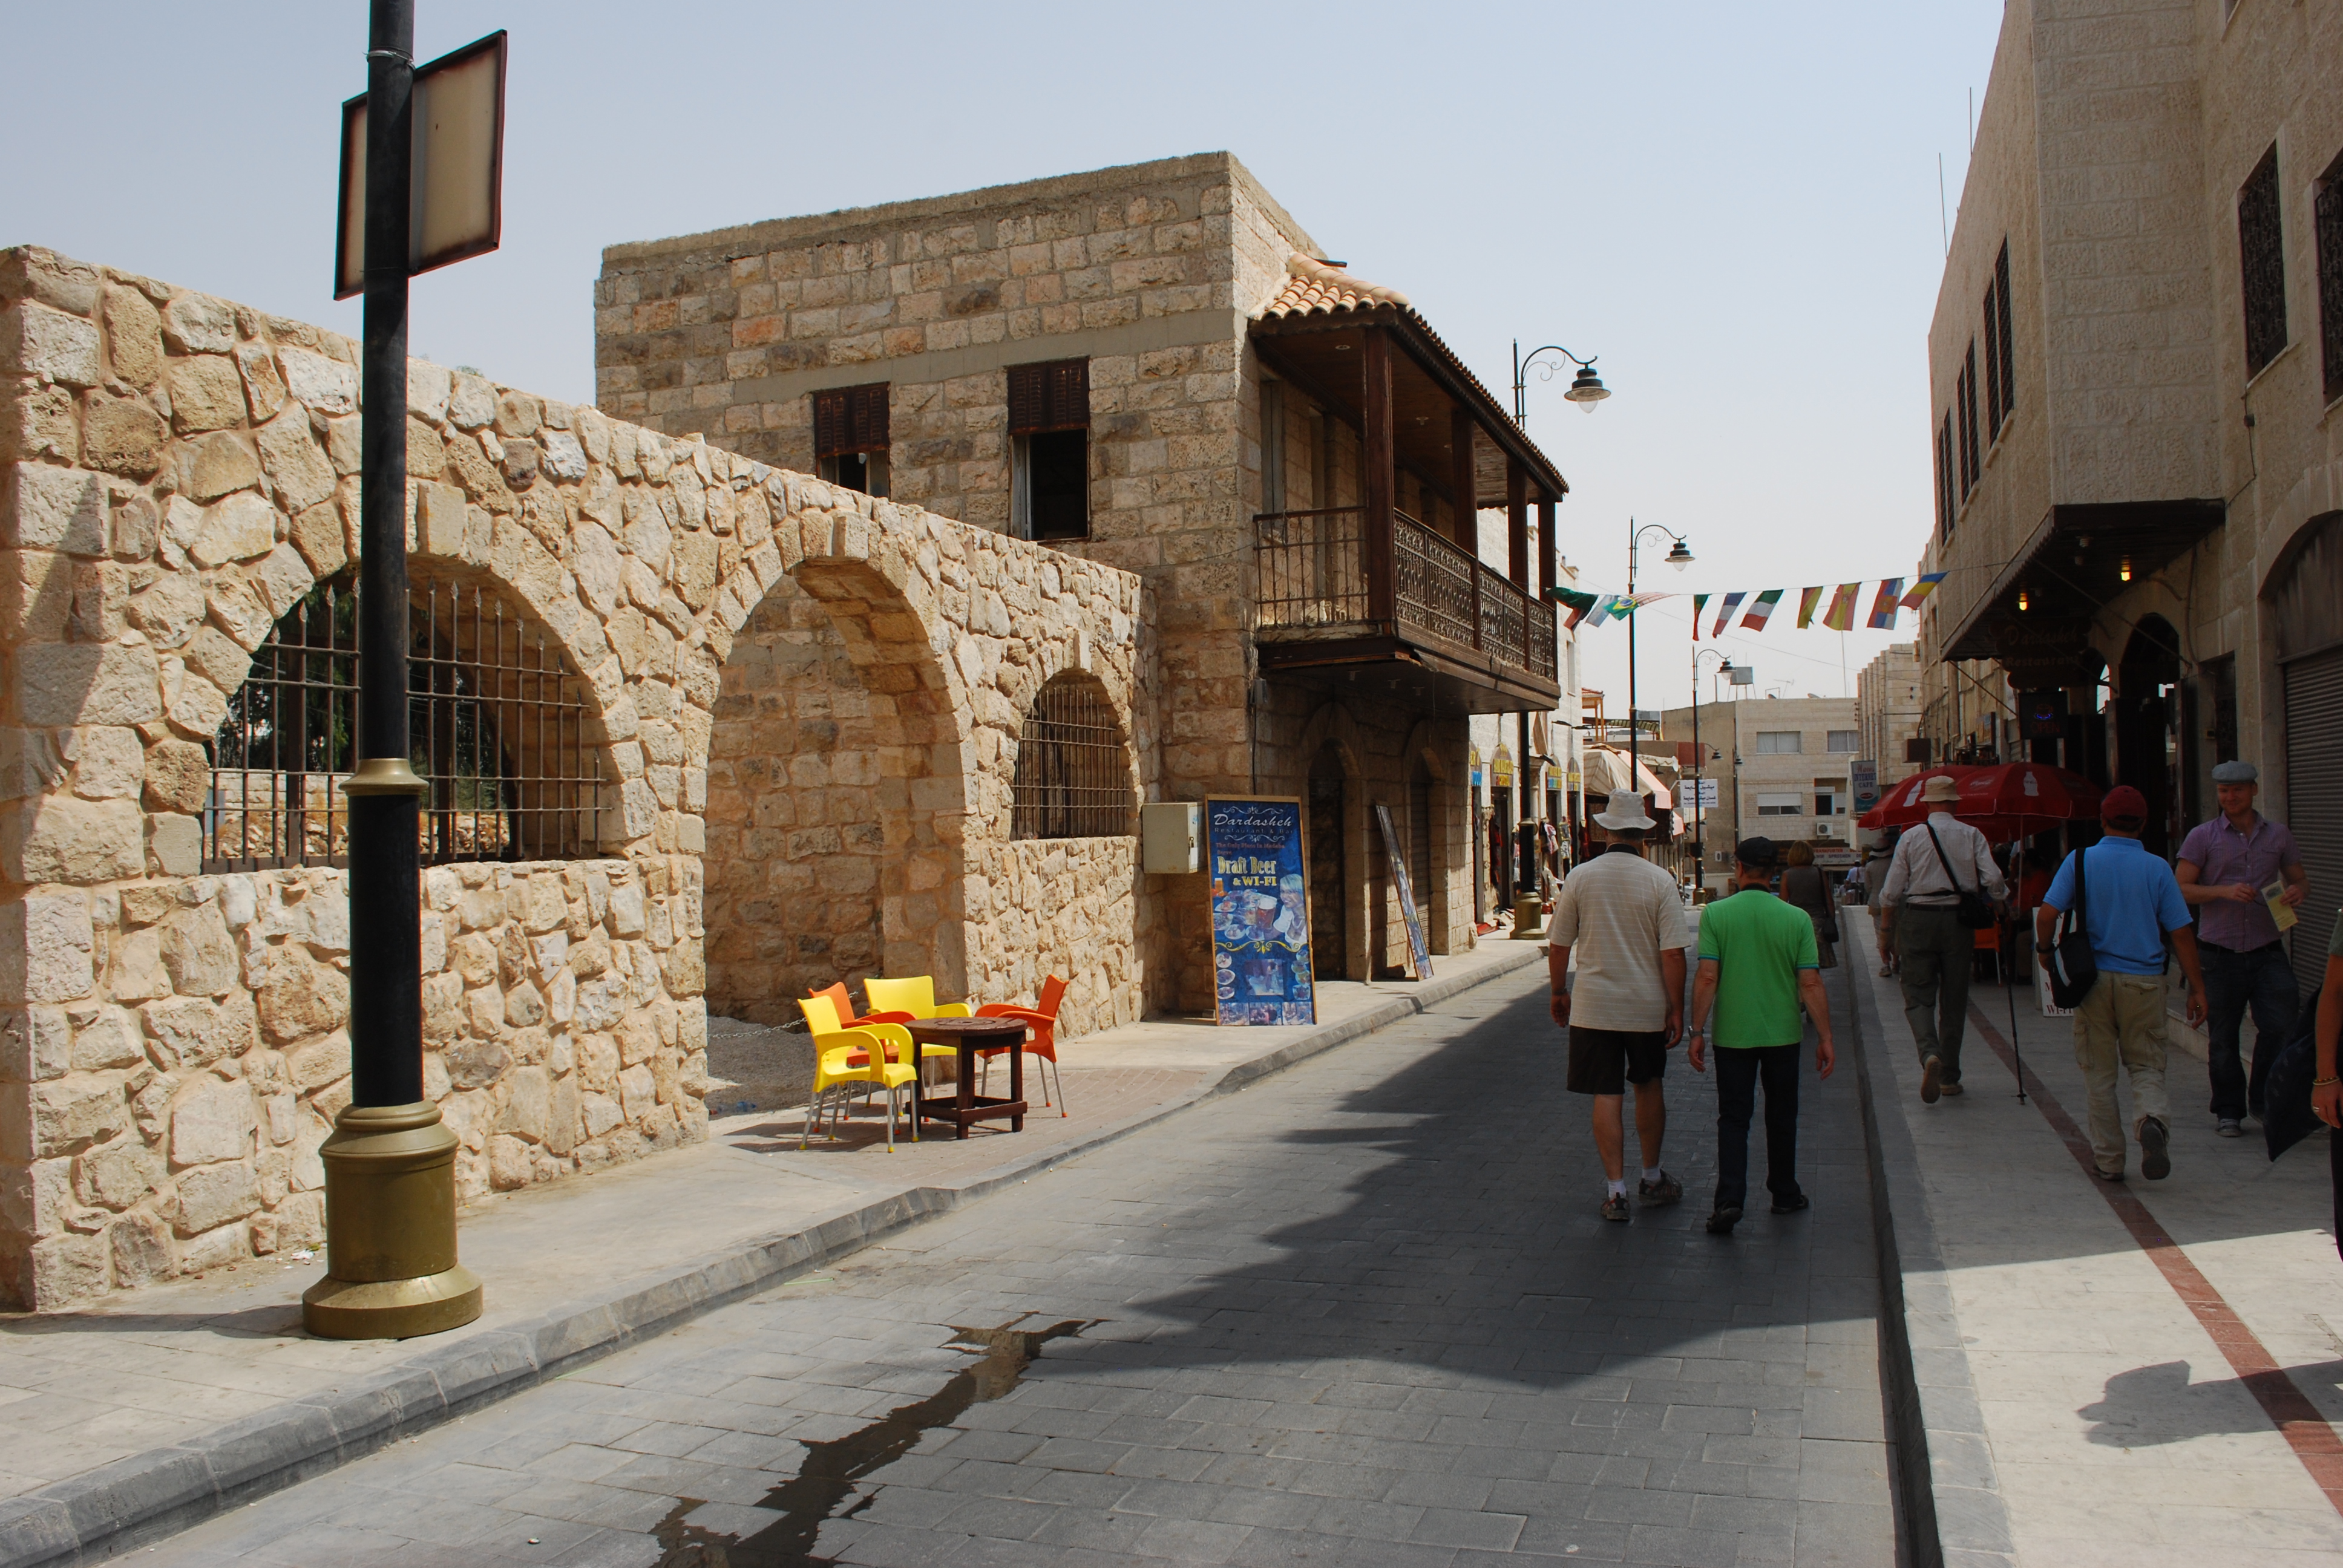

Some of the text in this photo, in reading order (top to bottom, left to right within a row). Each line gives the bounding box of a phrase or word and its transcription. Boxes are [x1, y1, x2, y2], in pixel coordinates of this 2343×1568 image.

[2031, 721, 2060, 733] OPEN
[1213, 814, 1293, 827] Dardasheh
[1217, 856, 1277, 874] Draft Beer
[1233, 876, 1277, 886] & WI-FI
